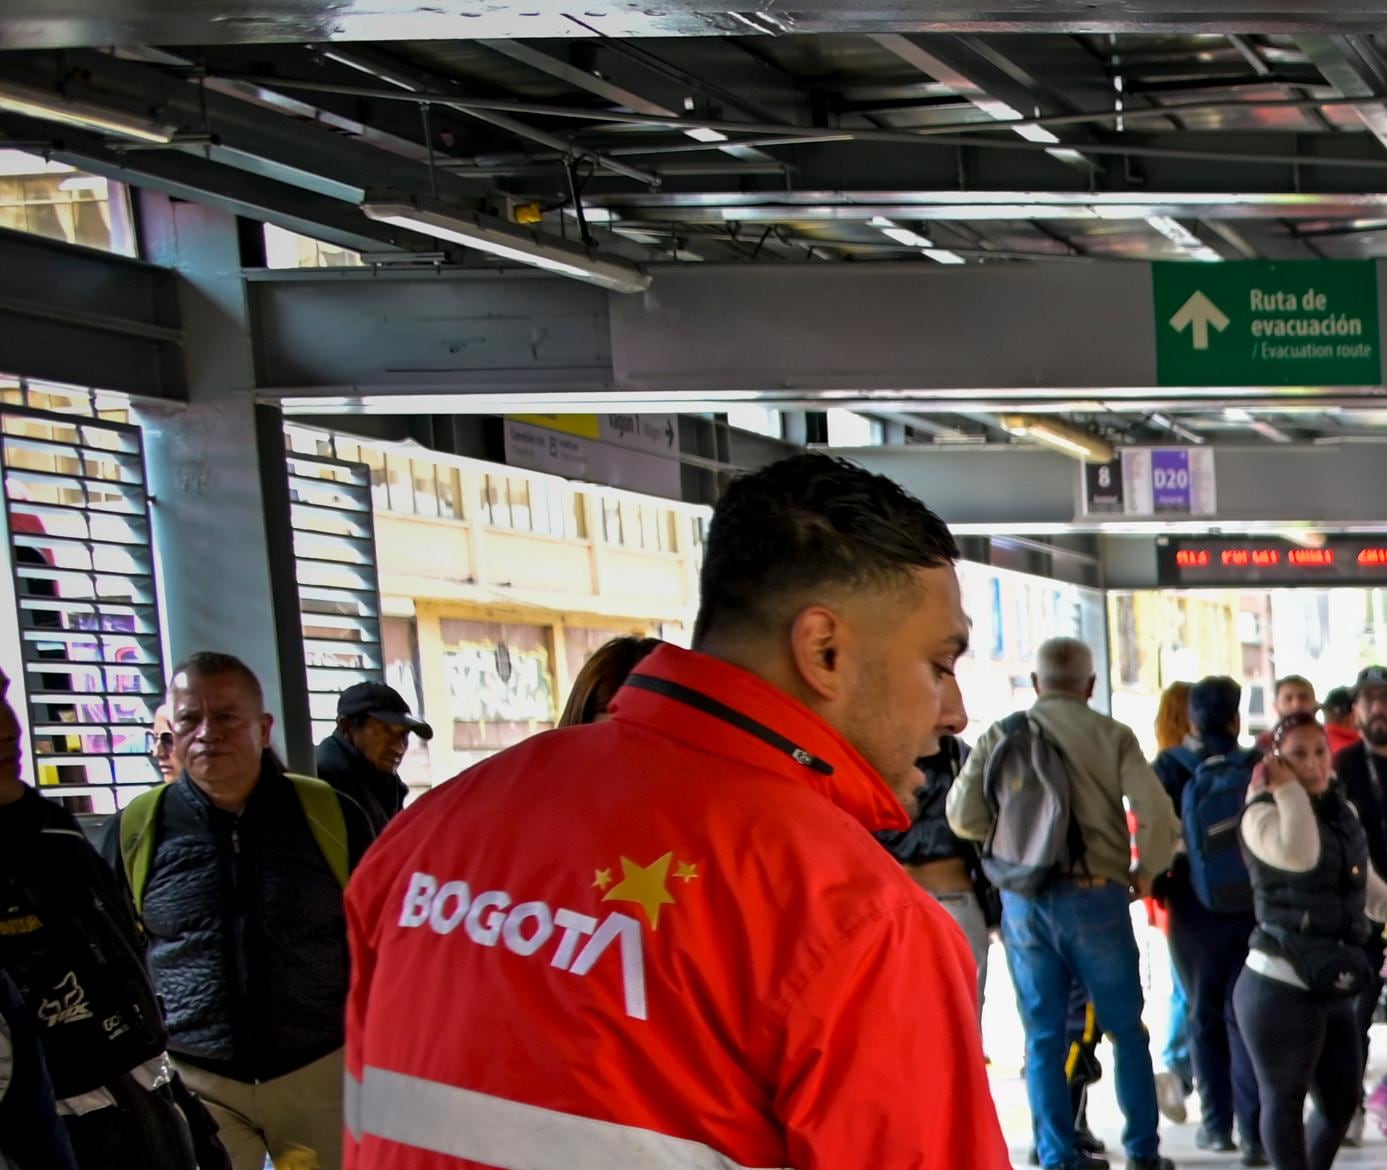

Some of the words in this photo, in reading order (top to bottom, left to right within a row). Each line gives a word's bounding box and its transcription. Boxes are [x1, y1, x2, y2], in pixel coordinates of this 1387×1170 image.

[1250, 288, 1297, 311] Ruta
[1302, 288, 1327, 311] de
[1251, 313, 1362, 336] evacuación
[1261, 342, 1333, 359] Evacuation
[1336, 345, 1372, 358] route
[1098, 465, 1111, 488] 8
[1154, 468, 1188, 489] D20
